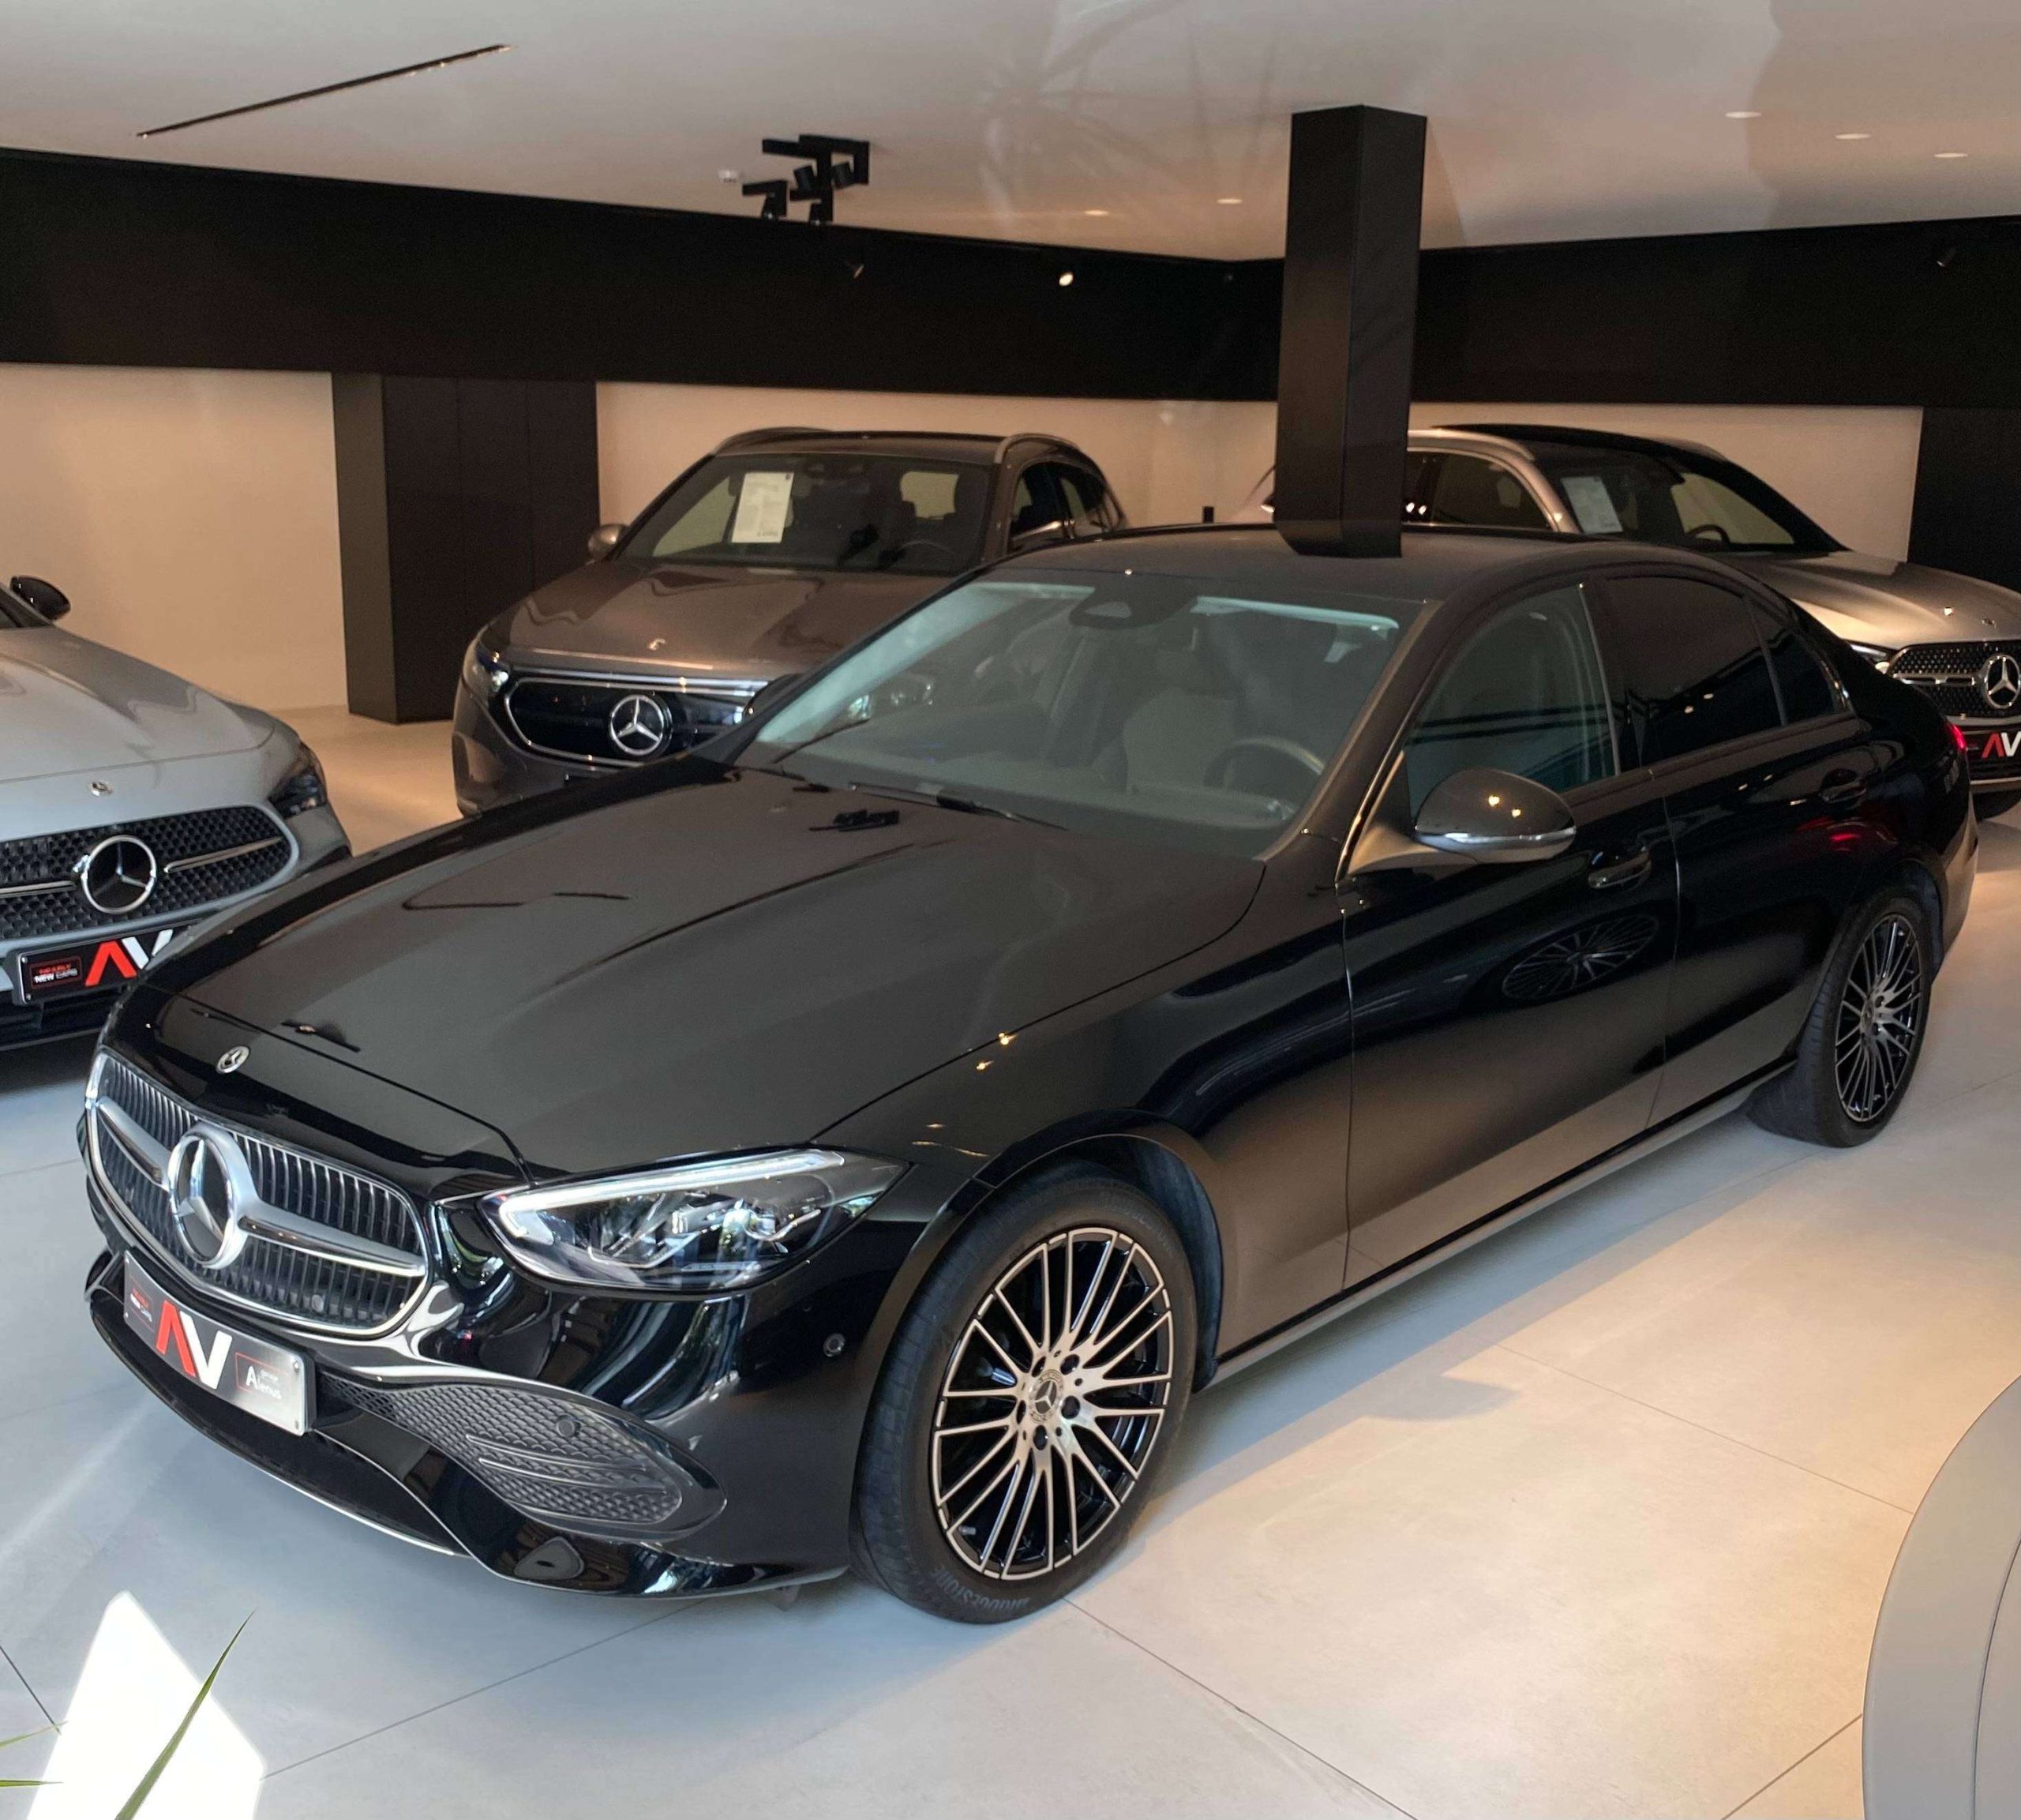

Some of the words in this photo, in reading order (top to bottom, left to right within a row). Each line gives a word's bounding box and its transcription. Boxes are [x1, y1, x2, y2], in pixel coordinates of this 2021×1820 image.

[34, 972, 55, 983] NEW
[156, 1300, 233, 1390] AV
[246, 1365, 282, 1400] Alenus
